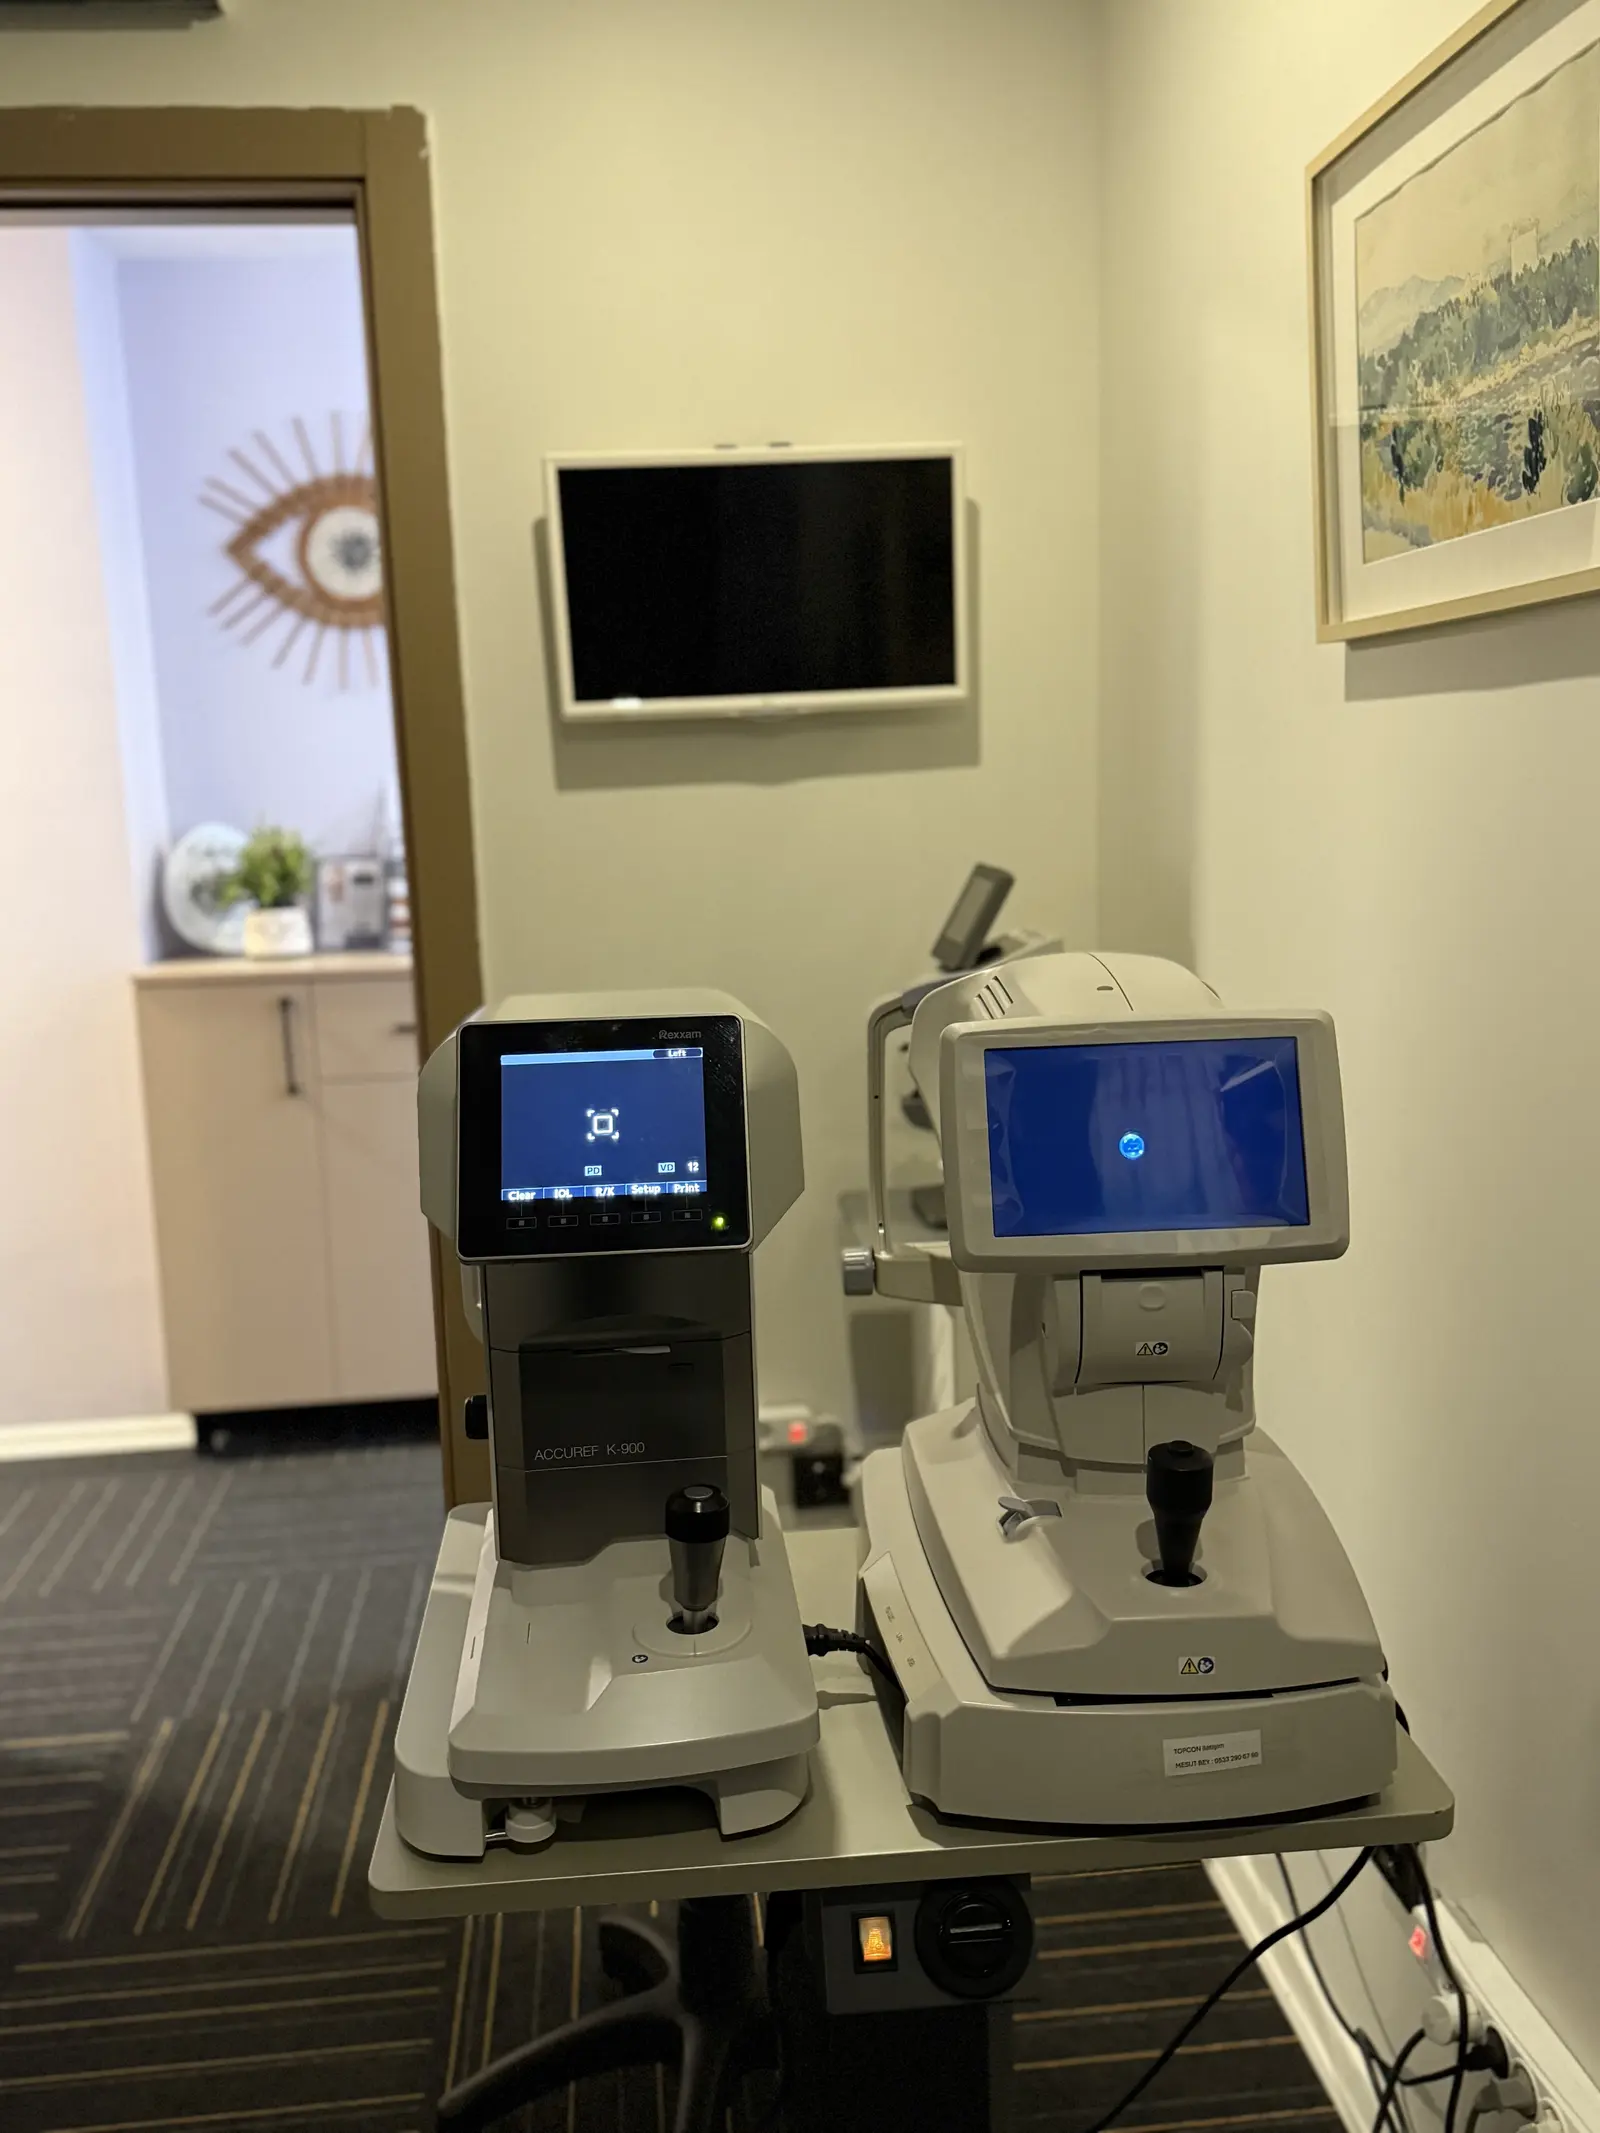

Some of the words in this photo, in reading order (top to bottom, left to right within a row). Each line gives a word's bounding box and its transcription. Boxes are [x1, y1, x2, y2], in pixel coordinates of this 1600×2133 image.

[658, 1030, 702, 1040] Rexxam
[668, 1048, 687, 1058] Left
[587, 1166, 601, 1175] PD
[660, 1163, 674, 1172] VD
[687, 1161, 699, 1172] 12
[595, 1186, 615, 1196] R/K
[631, 1184, 661, 1195] Setup
[674, 1182, 700, 1193] Print
[508, 1190, 536, 1200] Clear
[554, 1188, 573, 1198] IOL
[534, 1445, 599, 1461] ACCUREF
[606, 1442, 645, 1455] K-900
[1173, 1746, 1201, 1754] TOPCON
[1175, 1760, 1197, 1768] MESUT
